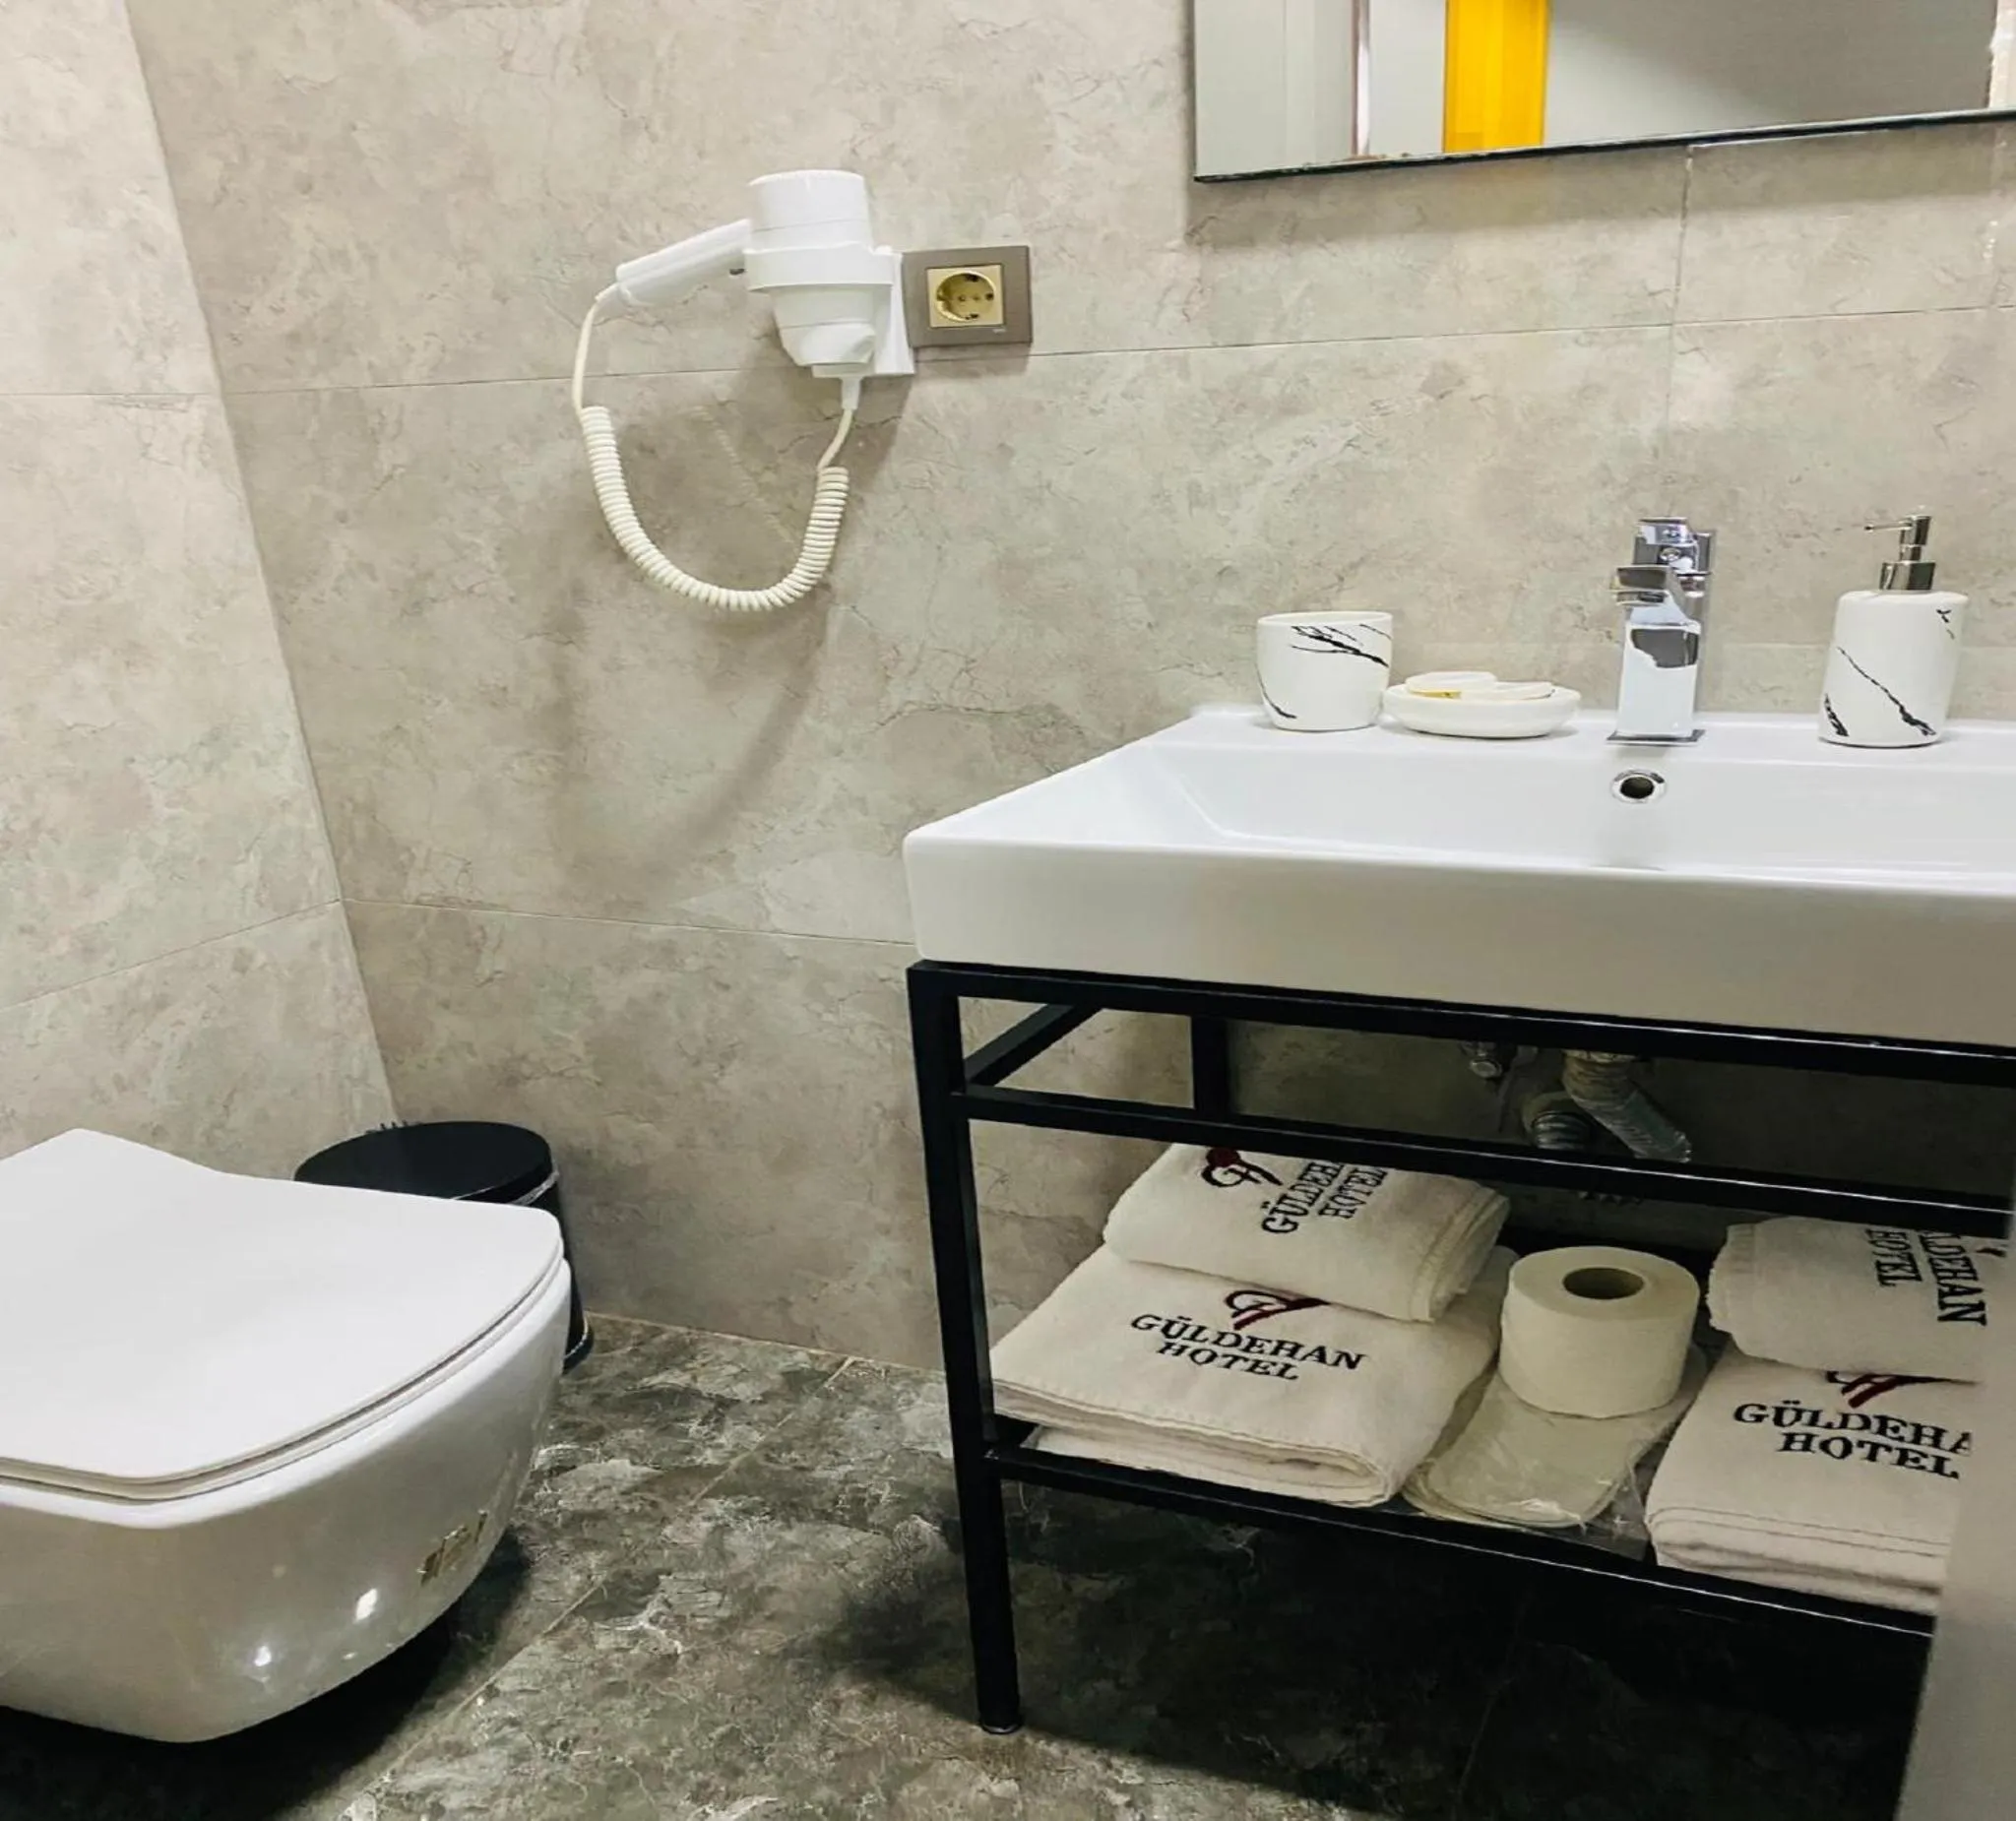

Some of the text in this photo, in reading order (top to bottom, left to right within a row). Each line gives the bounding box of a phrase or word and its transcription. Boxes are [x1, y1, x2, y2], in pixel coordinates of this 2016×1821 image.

[1261, 1162, 1345, 1234] GÜLDEH
[1318, 1167, 1388, 1219] HOTEL
[1865, 1229, 1922, 1287] HOTEL
[1919, 1232, 1986, 1326] LDEHAN
[1131, 1313, 1366, 1370] GÜLDEHAN
[1156, 1341, 1299, 1381] HOTEL
[1732, 1399, 1972, 1457] GÜLDEHA
[1776, 1432, 1959, 1479] HOTEL
